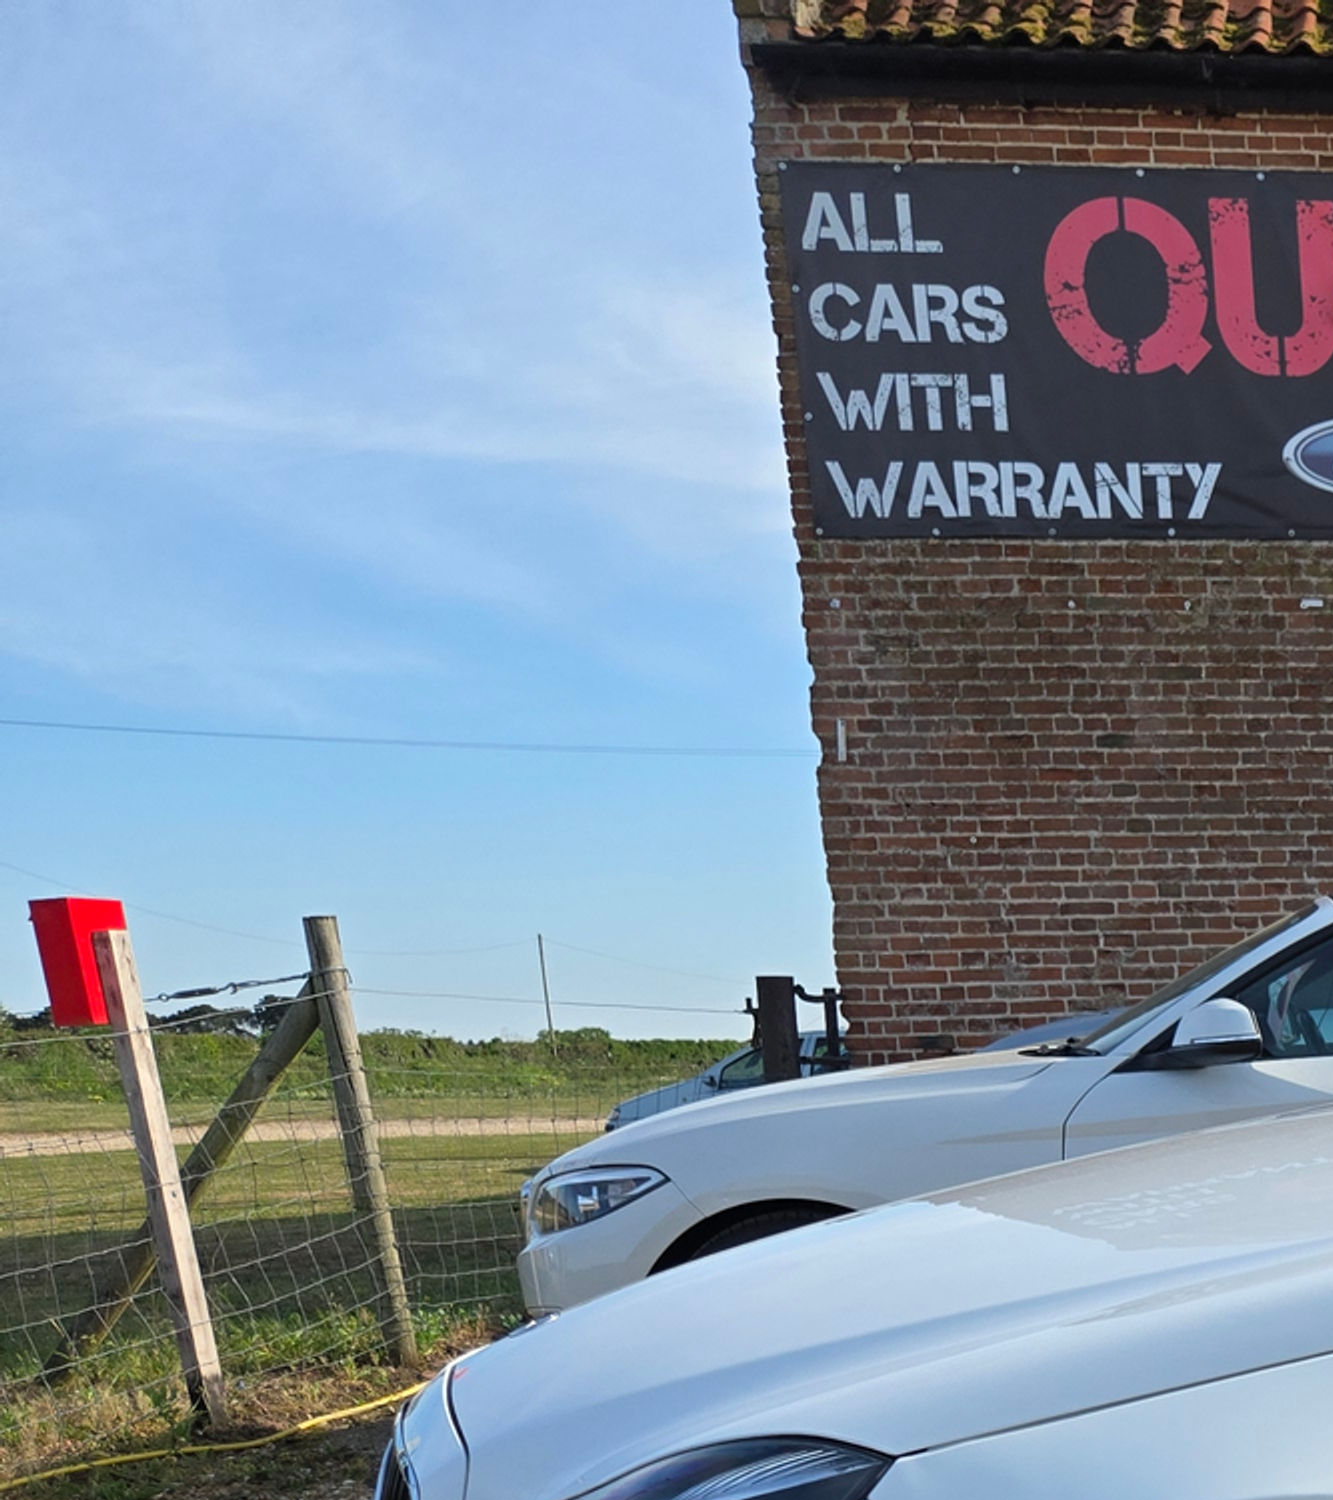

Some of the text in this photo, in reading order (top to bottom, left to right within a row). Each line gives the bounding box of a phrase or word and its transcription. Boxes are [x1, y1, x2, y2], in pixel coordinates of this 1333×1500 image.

[802, 192, 943, 253] ALL
[808, 282, 1009, 343] CARS
[816, 372, 1009, 432] WITH
[825, 460, 1222, 519] WARRANTY
